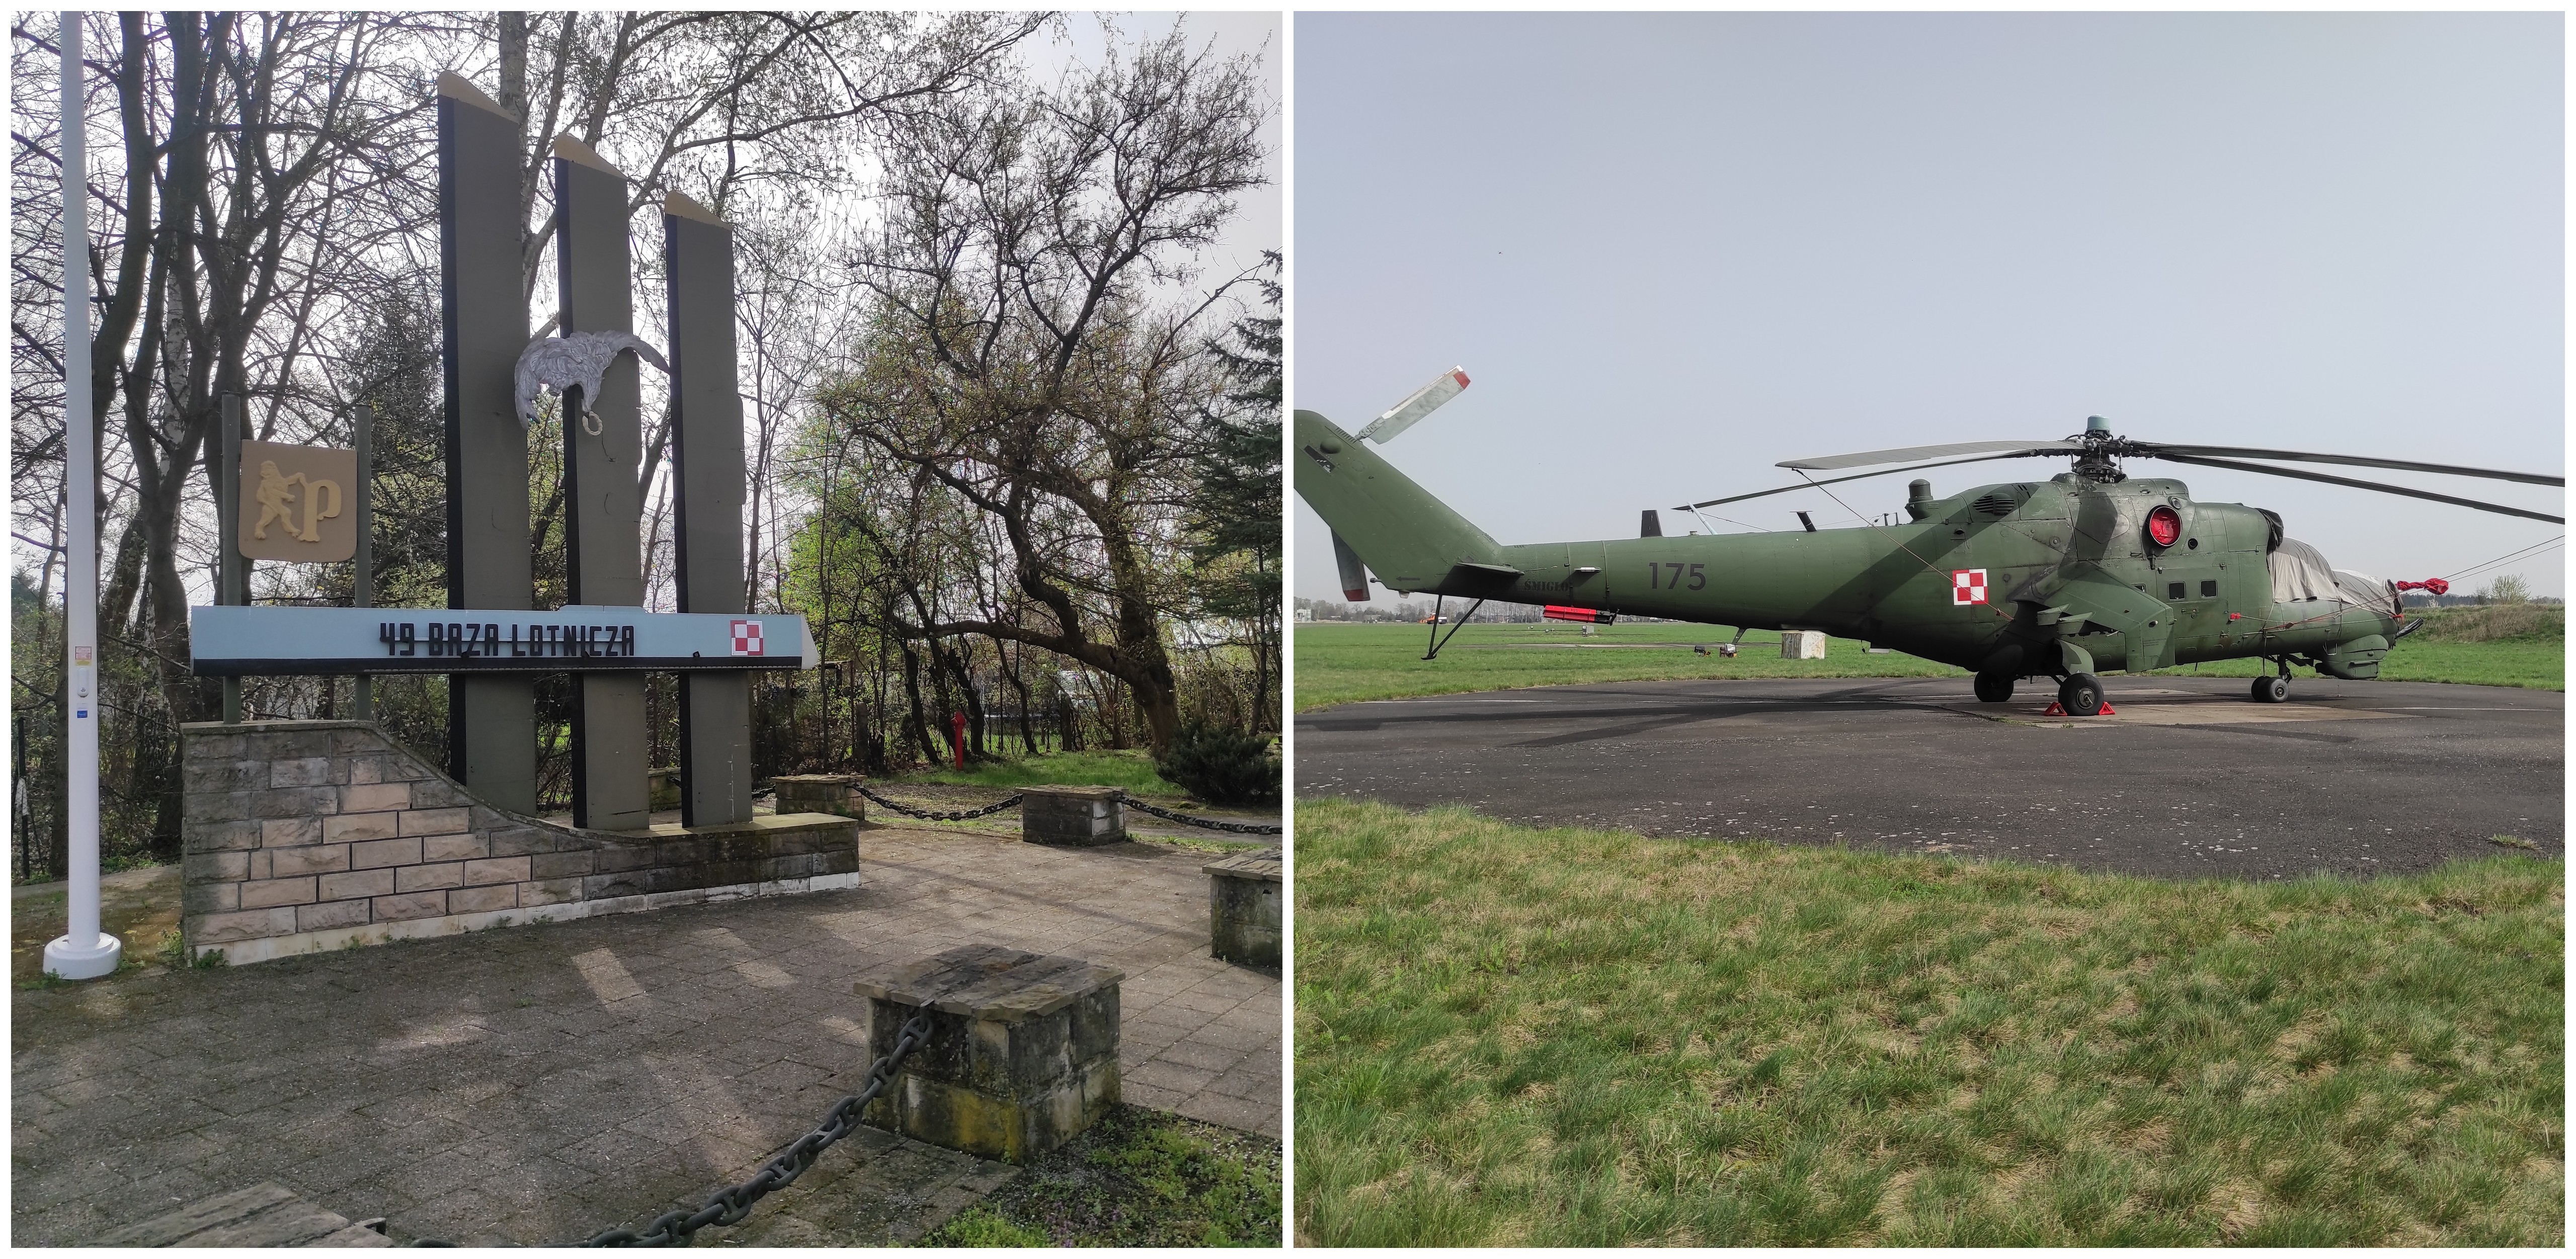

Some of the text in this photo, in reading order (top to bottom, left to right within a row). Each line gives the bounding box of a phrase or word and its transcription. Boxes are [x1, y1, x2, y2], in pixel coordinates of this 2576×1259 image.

[1649, 562, 1706, 591] 175
[380, 623, 634, 656] 49 BAZA LOTNICZA
